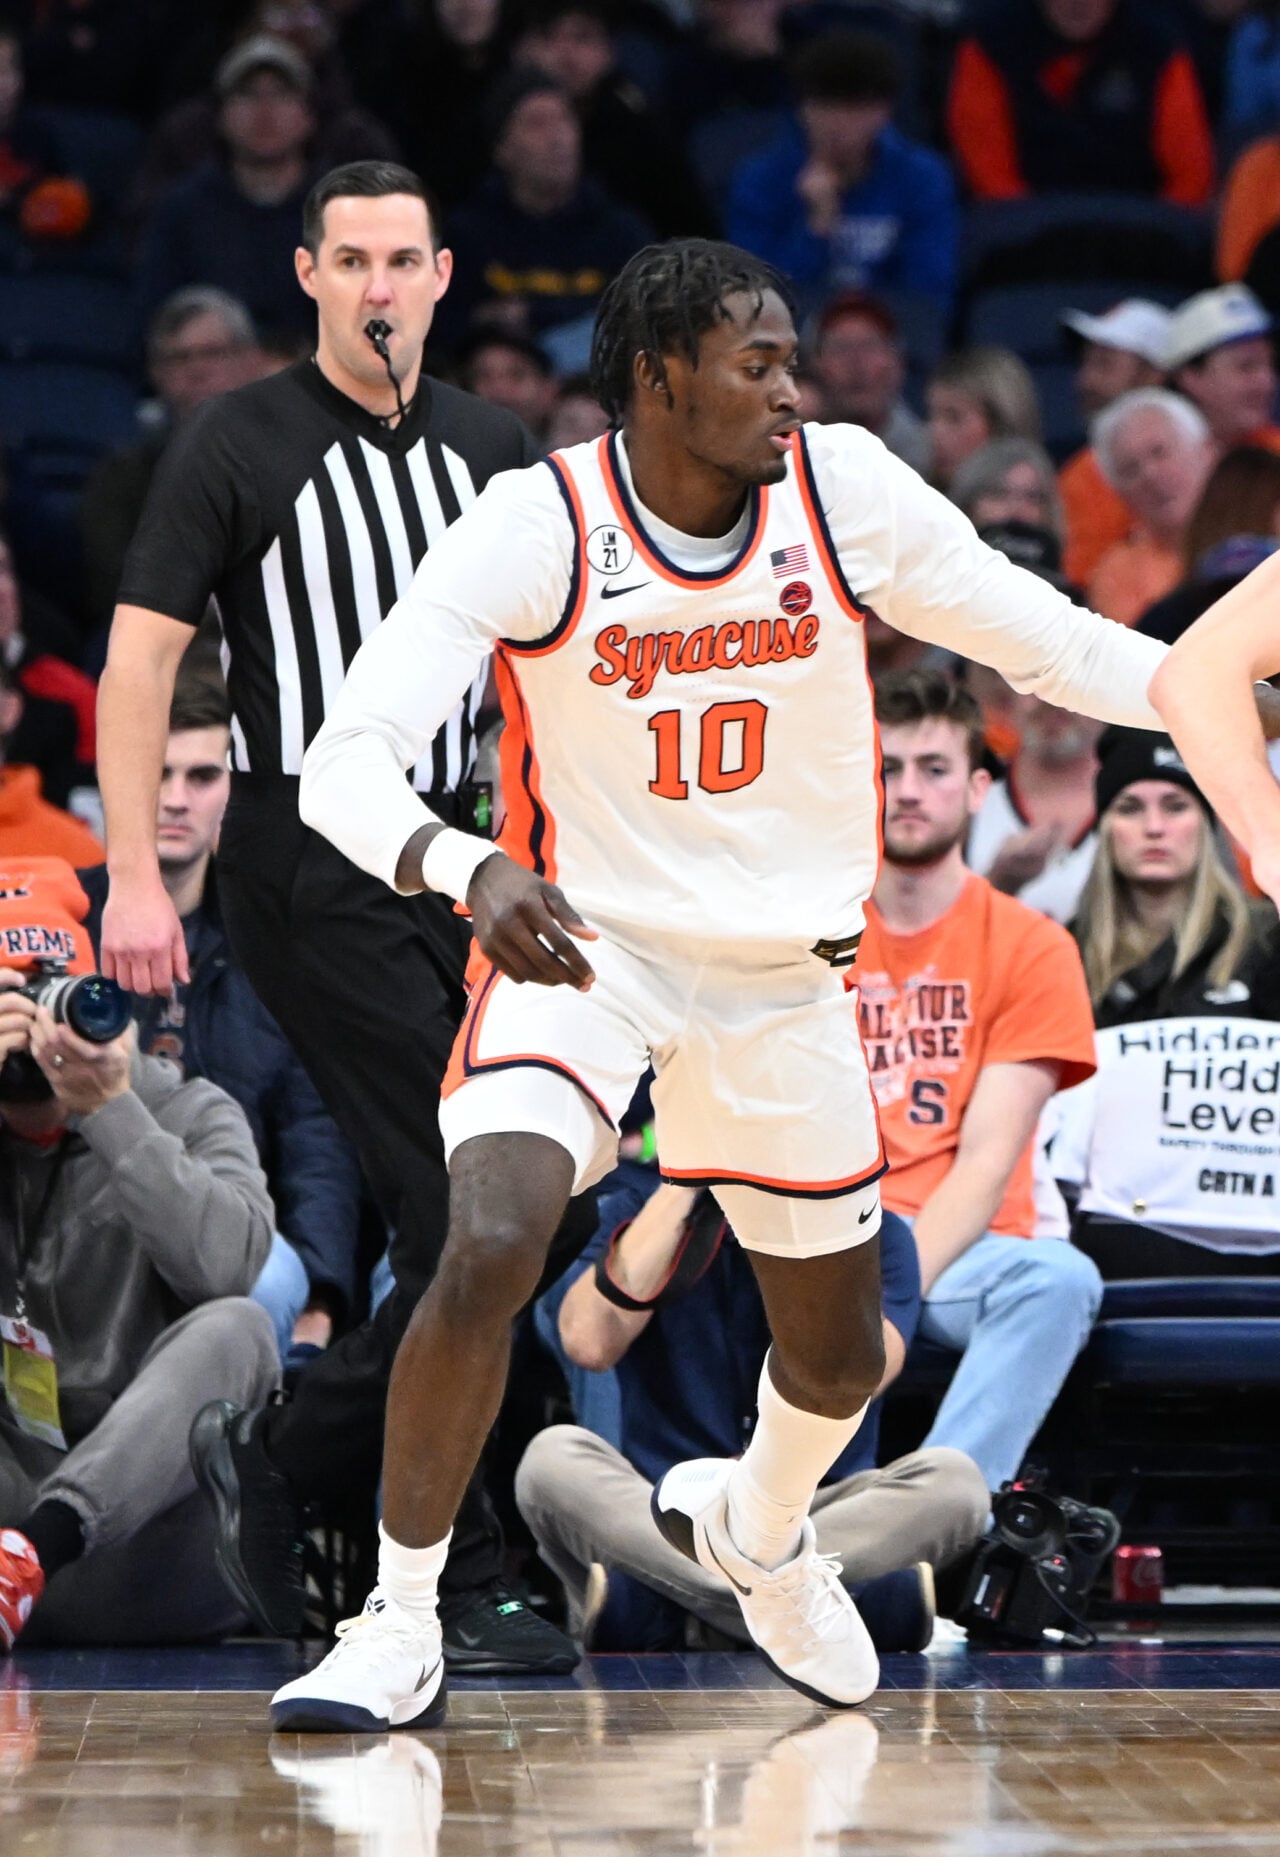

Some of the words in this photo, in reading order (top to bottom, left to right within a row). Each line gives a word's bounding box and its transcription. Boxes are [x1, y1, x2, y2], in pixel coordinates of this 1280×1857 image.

[602, 532, 616, 546] LM
[603, 548, 618, 568] 21
[589, 615, 819, 699] Syracuse
[648, 699, 769, 801] 10
[909, 1079, 947, 1124] S
[1199, 1168, 1255, 1195] CRTN
[1262, 1174, 1274, 1197] A
